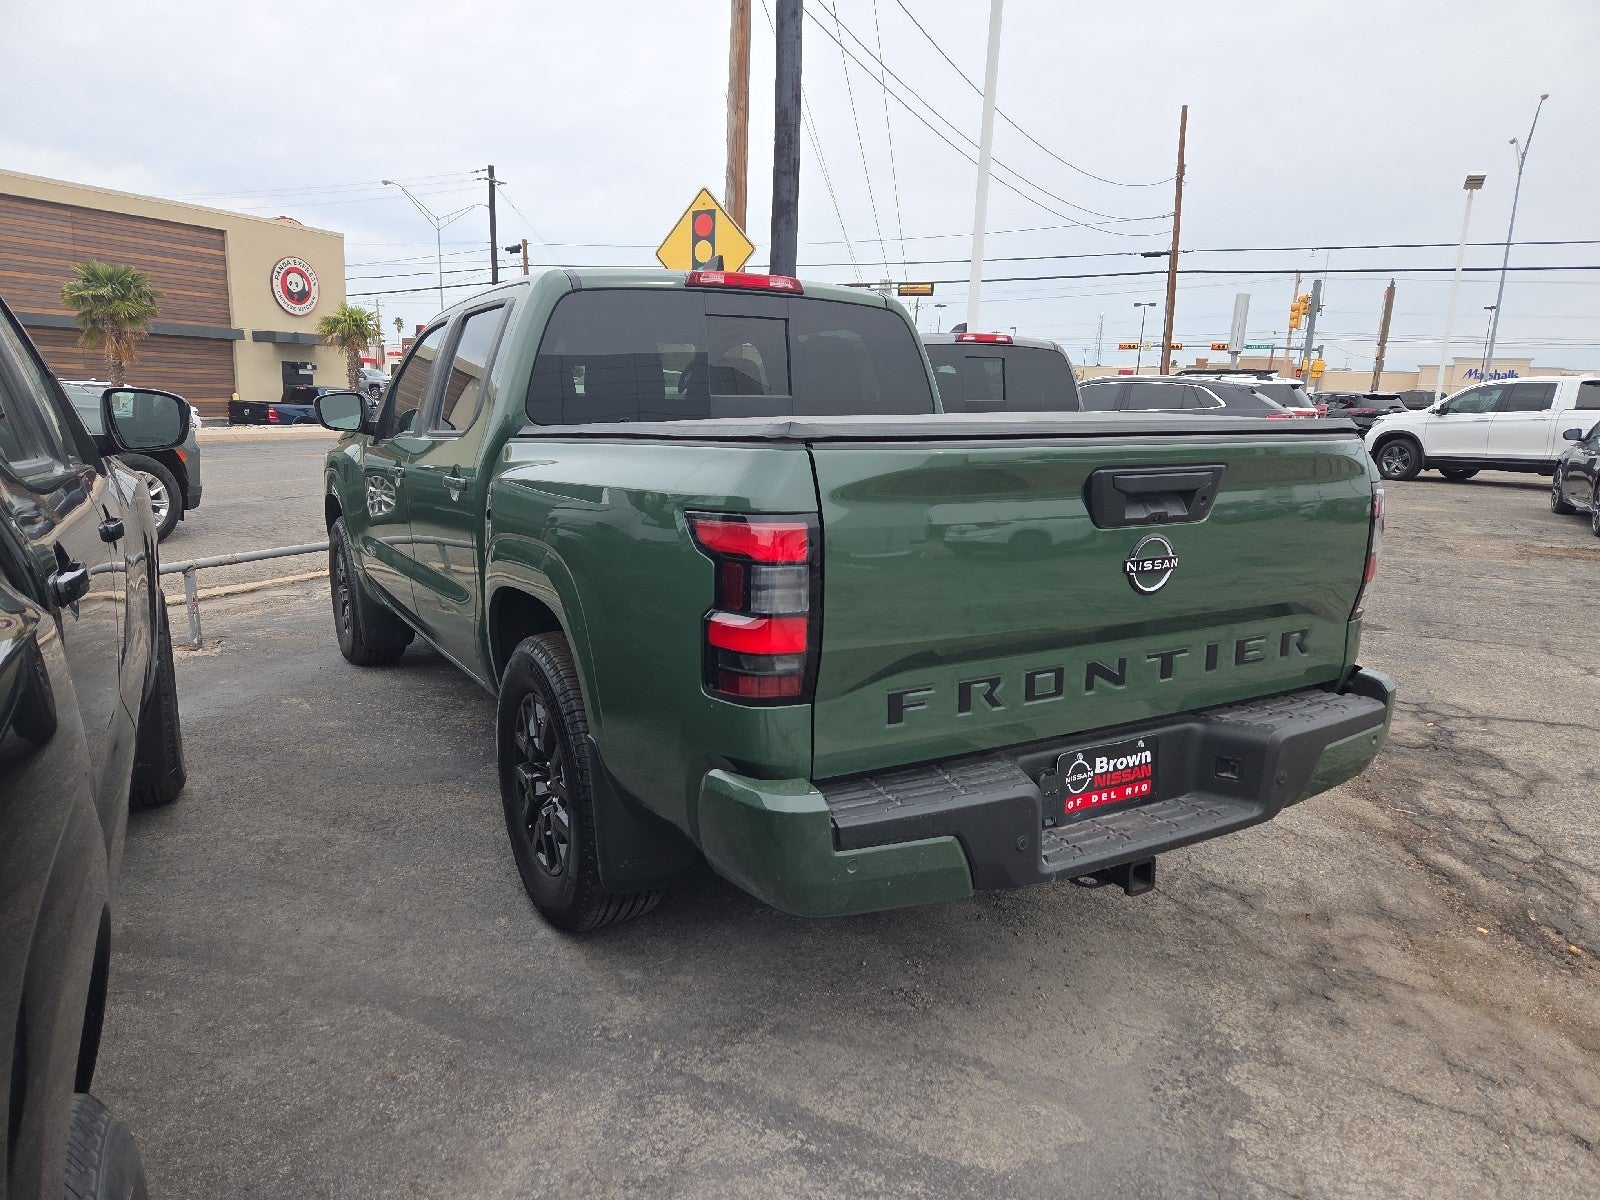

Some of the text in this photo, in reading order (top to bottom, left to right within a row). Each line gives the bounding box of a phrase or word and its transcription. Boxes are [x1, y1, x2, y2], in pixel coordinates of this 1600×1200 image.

[275, 260, 291, 280] PANDA
[1463, 369, 1518, 380] Mashalls
[1126, 557, 1178, 571] NISSAN
[887, 629, 1310, 727] FRONTIER
[1095, 751, 1151, 773] Brown
[1066, 771, 1093, 784] NISSAN
[1094, 764, 1151, 787] NISSAN
[1068, 784, 1147, 809] OF DEL RIO
